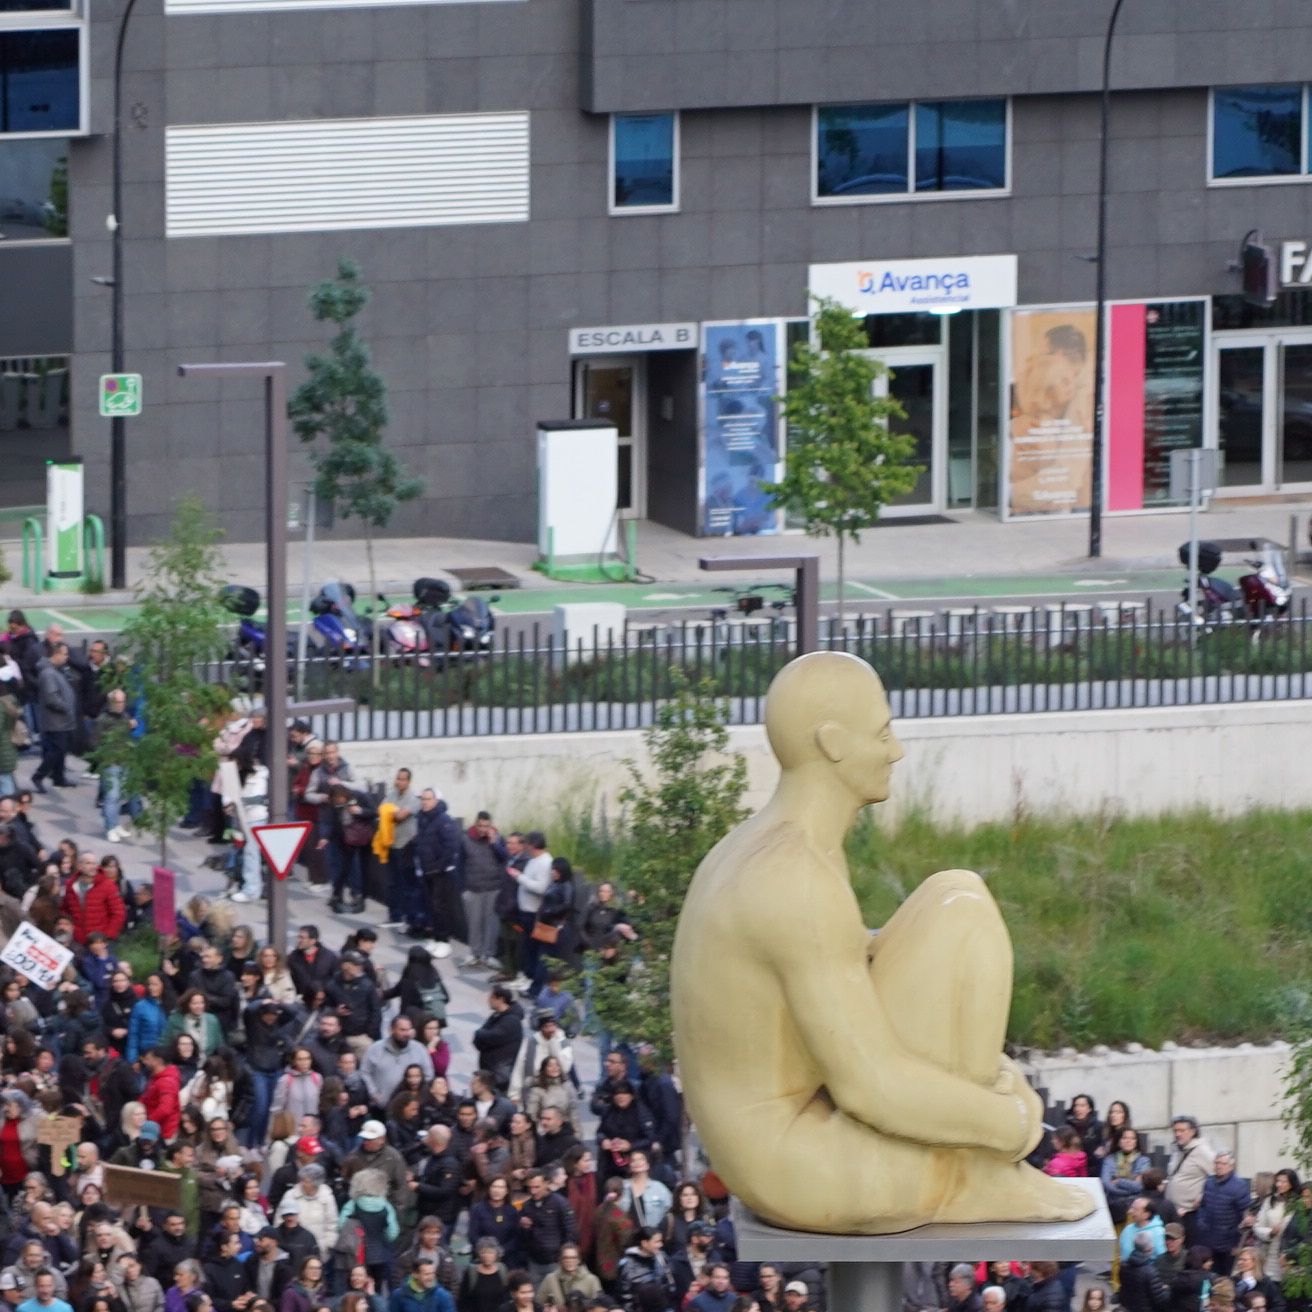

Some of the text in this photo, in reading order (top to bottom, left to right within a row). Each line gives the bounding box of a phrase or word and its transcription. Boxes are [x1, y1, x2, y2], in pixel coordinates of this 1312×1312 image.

[880, 271, 969, 294] Avança
[577, 328, 690, 347] ESCALA B
